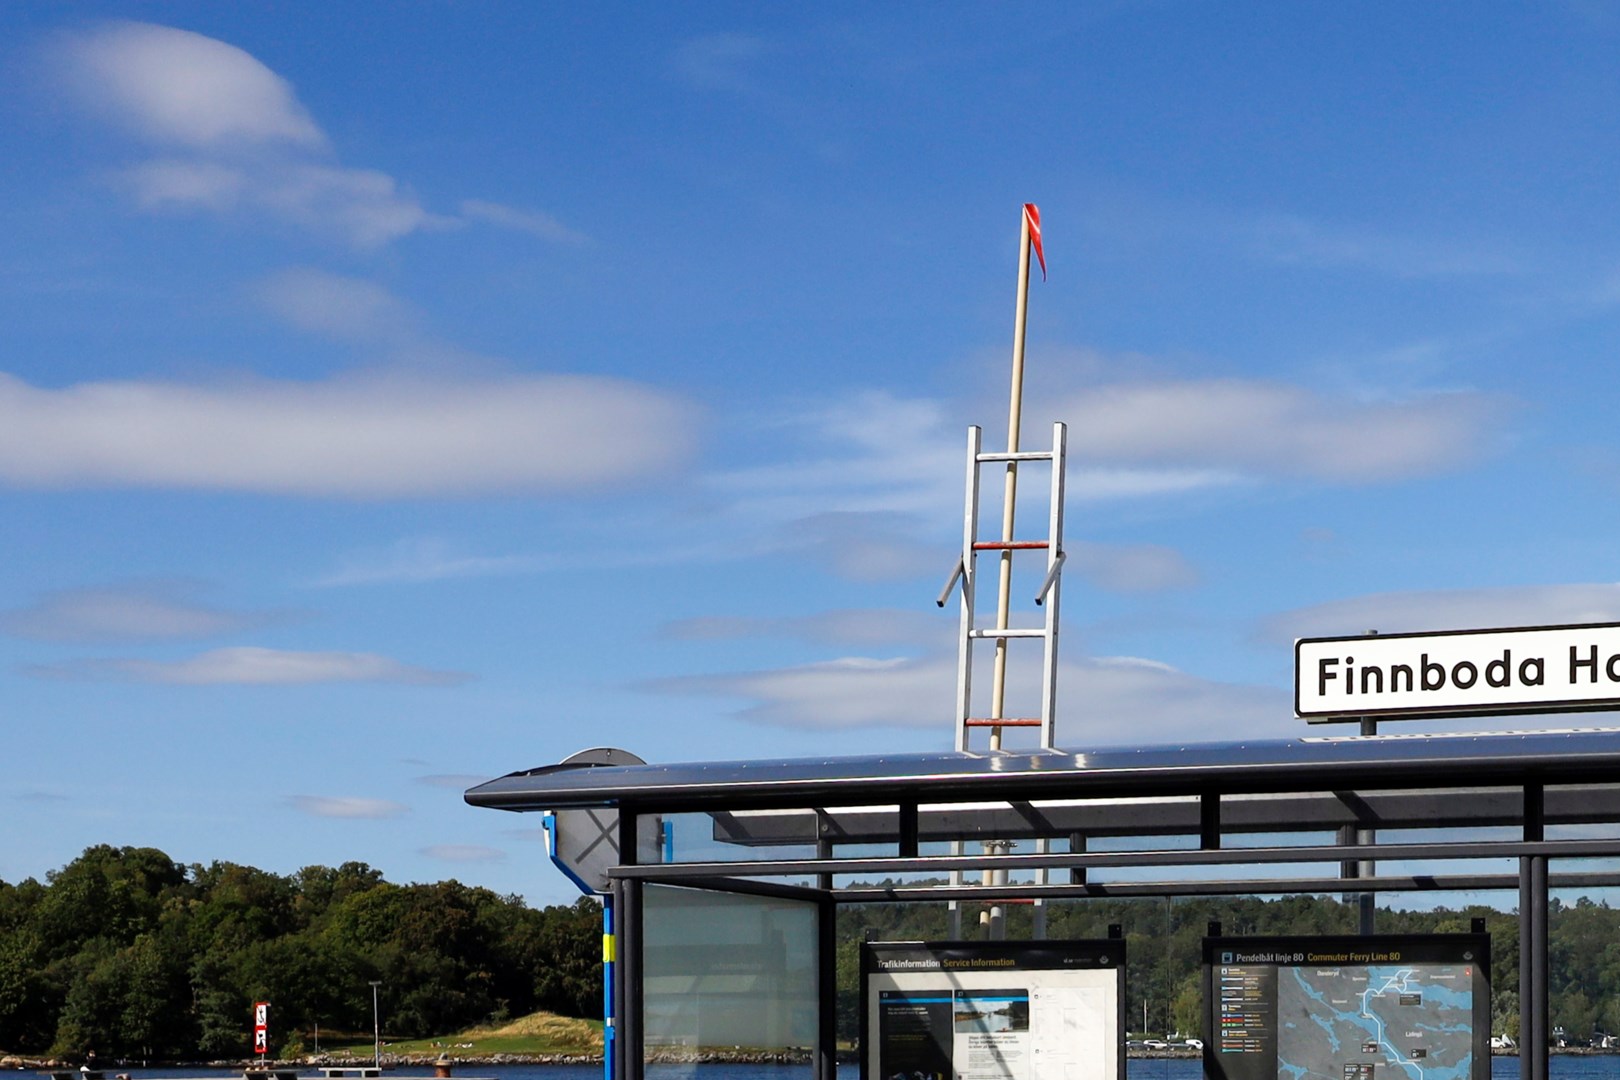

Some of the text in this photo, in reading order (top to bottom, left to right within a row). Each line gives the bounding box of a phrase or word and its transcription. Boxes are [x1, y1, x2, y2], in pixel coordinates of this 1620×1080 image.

[1319, 649, 1545, 696] Finnboda
[1236, 953, 1304, 963] Pendelbåt linje 80
[1307, 952, 1400, 963] Commuter Ferry Line 80
[877, 959, 941, 969] Trafikinformation
[943, 958, 1015, 968] Service Information
